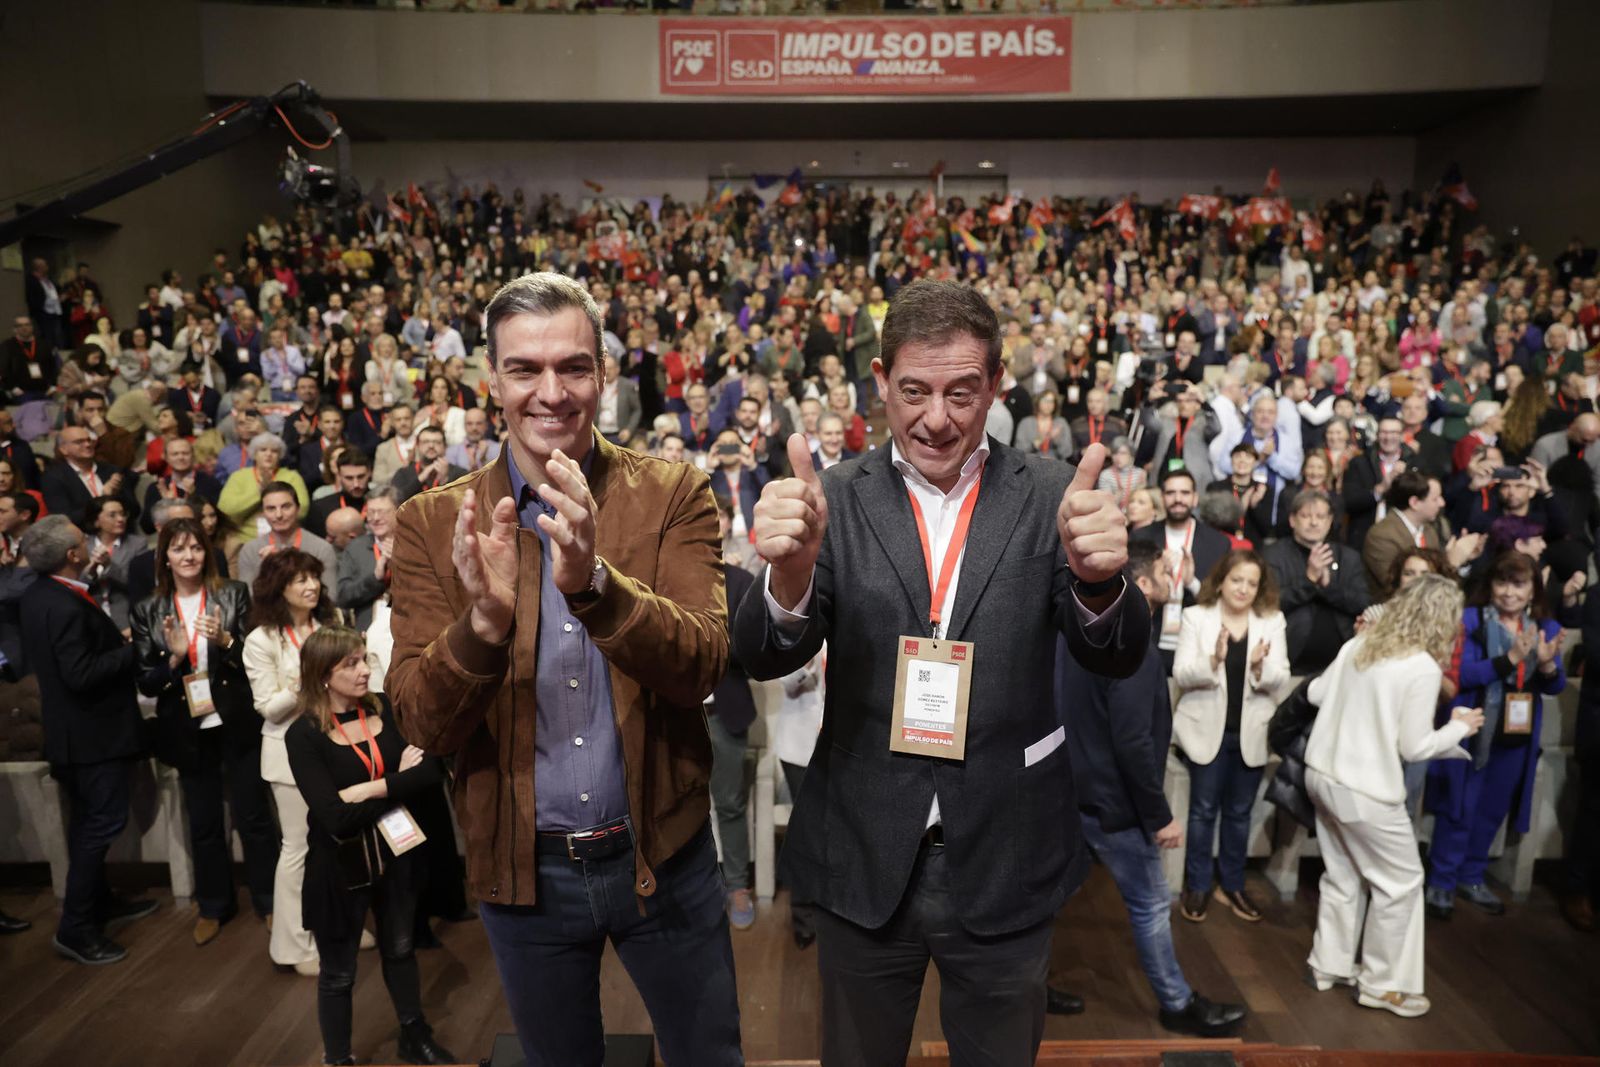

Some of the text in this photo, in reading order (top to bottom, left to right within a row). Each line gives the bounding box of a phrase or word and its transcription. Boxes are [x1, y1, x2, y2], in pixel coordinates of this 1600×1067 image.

[672, 40, 714, 58] PSOE
[781, 25, 1065, 58] IMPULSO DE PAÍS.
[730, 59, 774, 79] S&D
[780, 58, 945, 76] ESPAÑA AVANZA.
[904, 734, 930, 743] IMPULSO
